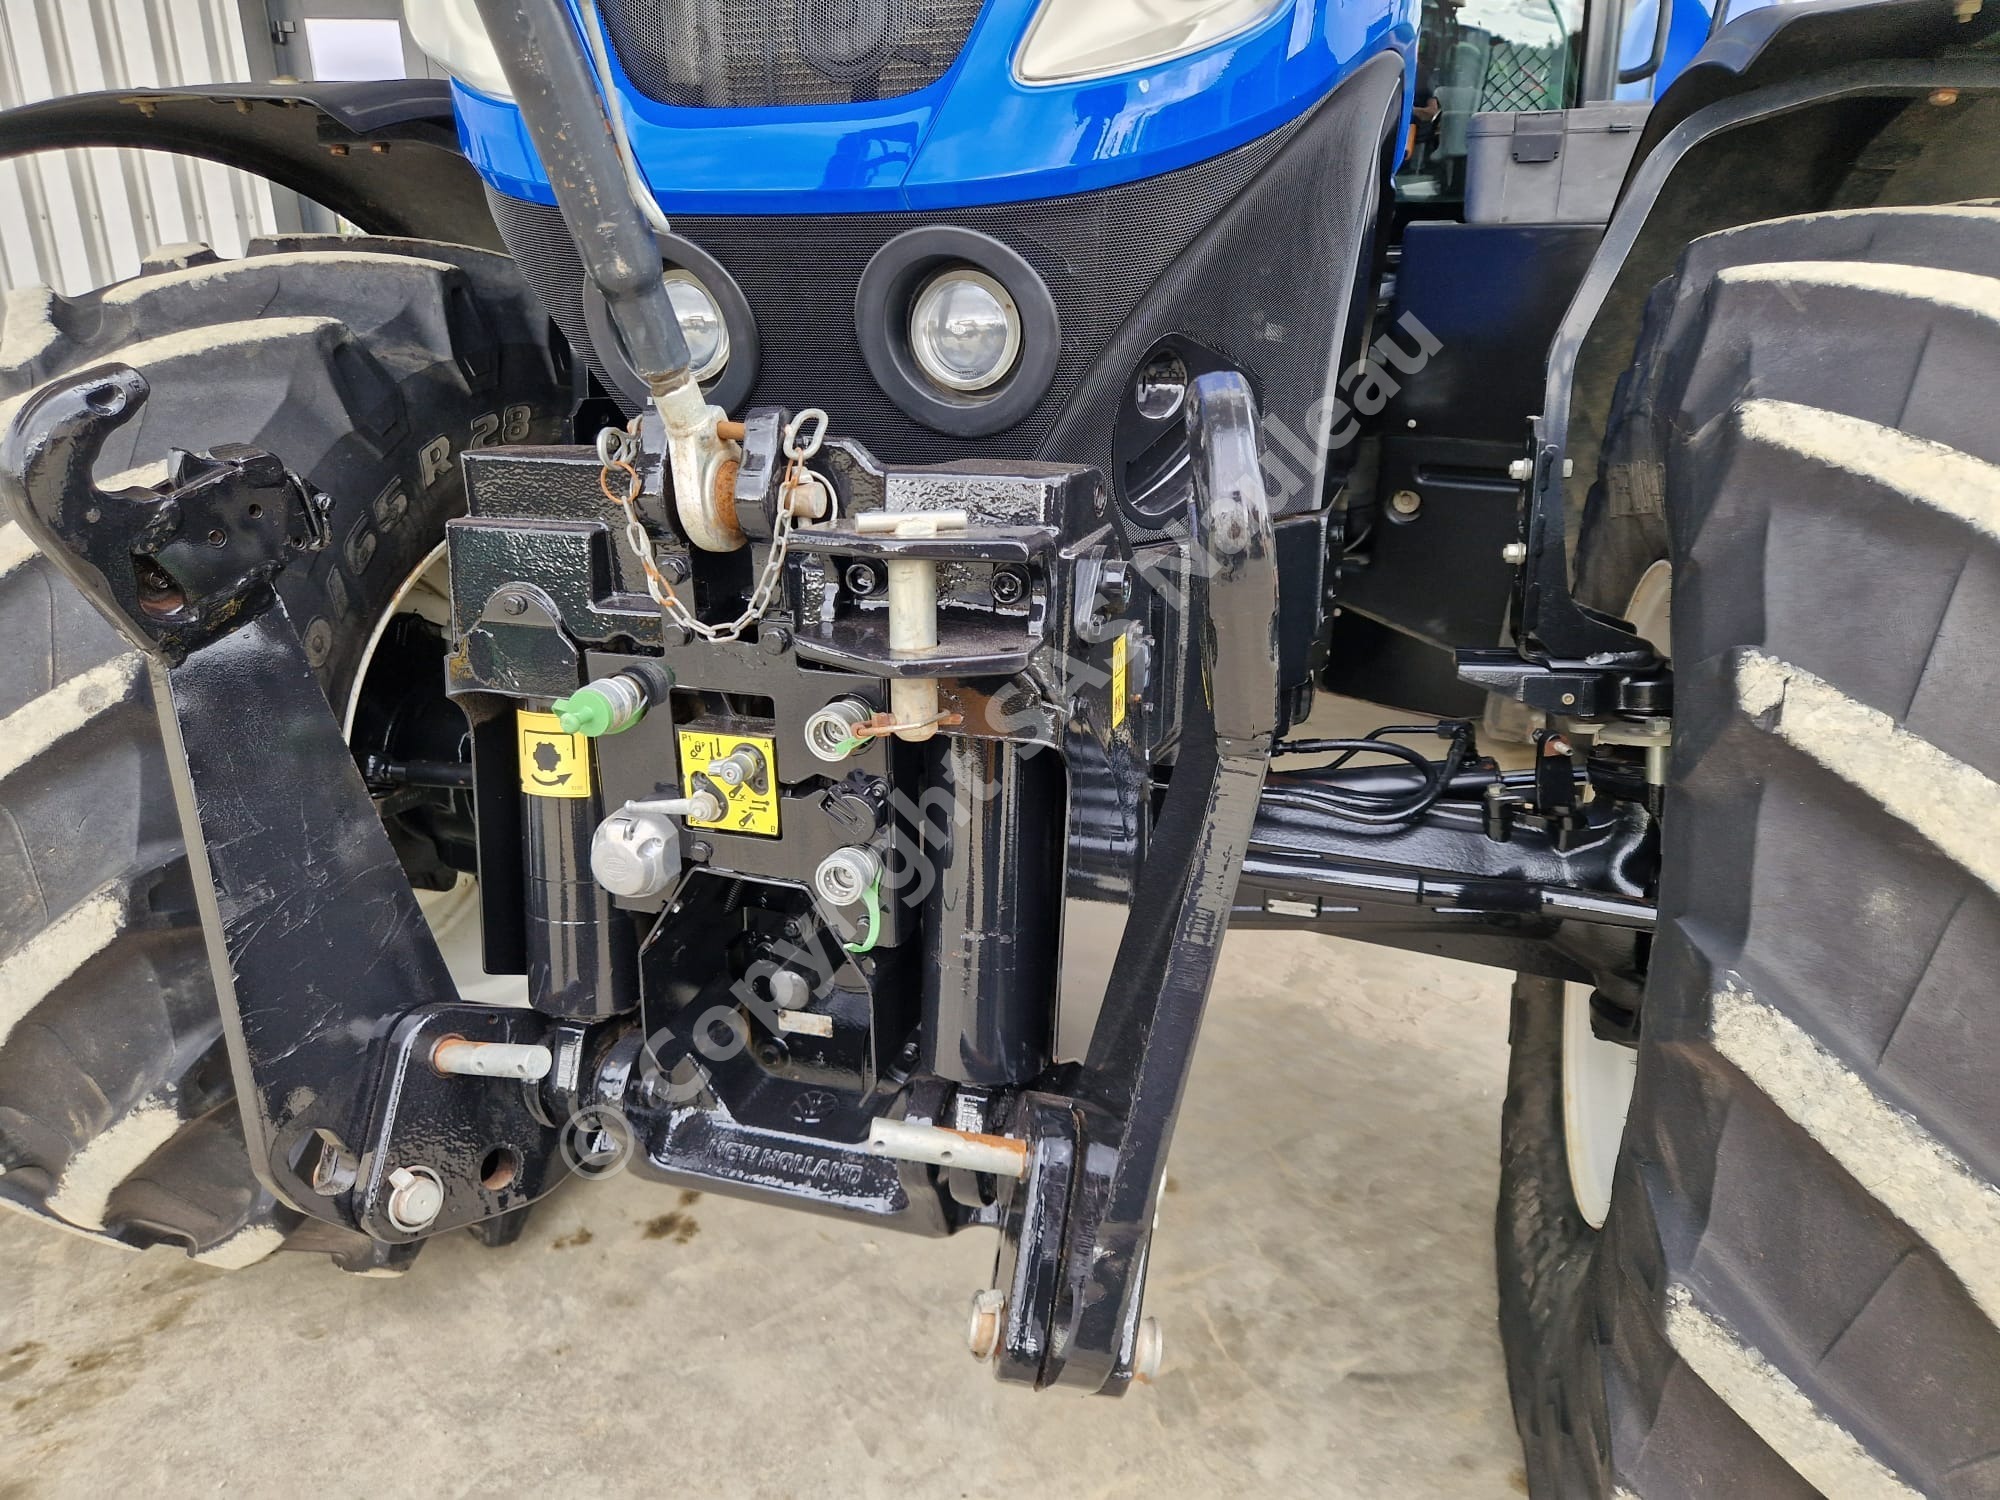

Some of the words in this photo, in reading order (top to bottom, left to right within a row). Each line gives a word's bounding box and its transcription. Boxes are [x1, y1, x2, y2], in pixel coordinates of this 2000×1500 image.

[418, 433, 453, 488] R
[470, 404, 532, 450] 28
[681, 733, 692, 742] P1
[690, 816, 700, 825] P2
[706, 1138, 760, 1162] NEW
[758, 1148, 864, 1185] HOLLAND
